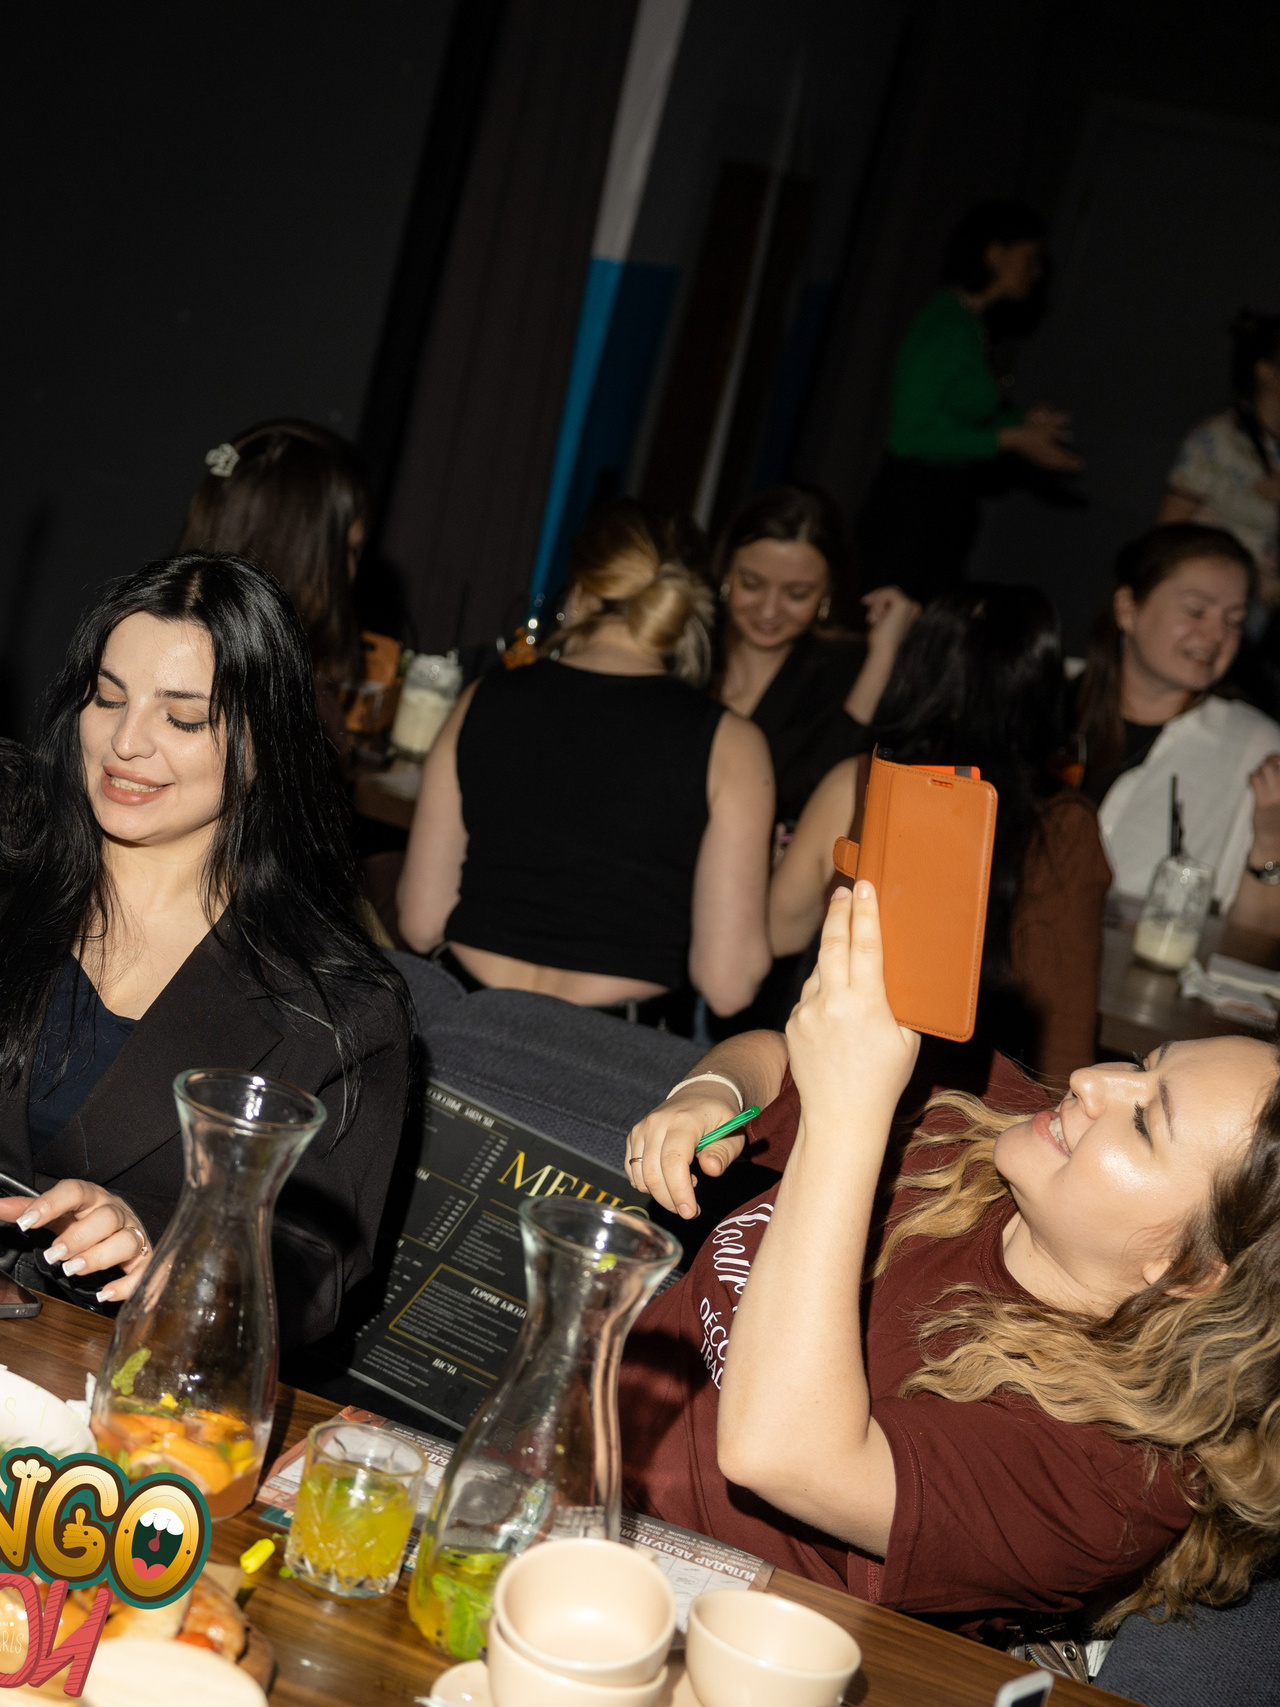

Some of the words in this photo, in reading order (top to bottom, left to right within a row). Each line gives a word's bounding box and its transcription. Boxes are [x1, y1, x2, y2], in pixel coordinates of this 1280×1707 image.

[497, 1150, 650, 1220] МЕ
[621, 1528, 694, 1559] АБДУЛЛИ
[695, 1557, 755, 1582] ИЛЬДАР
